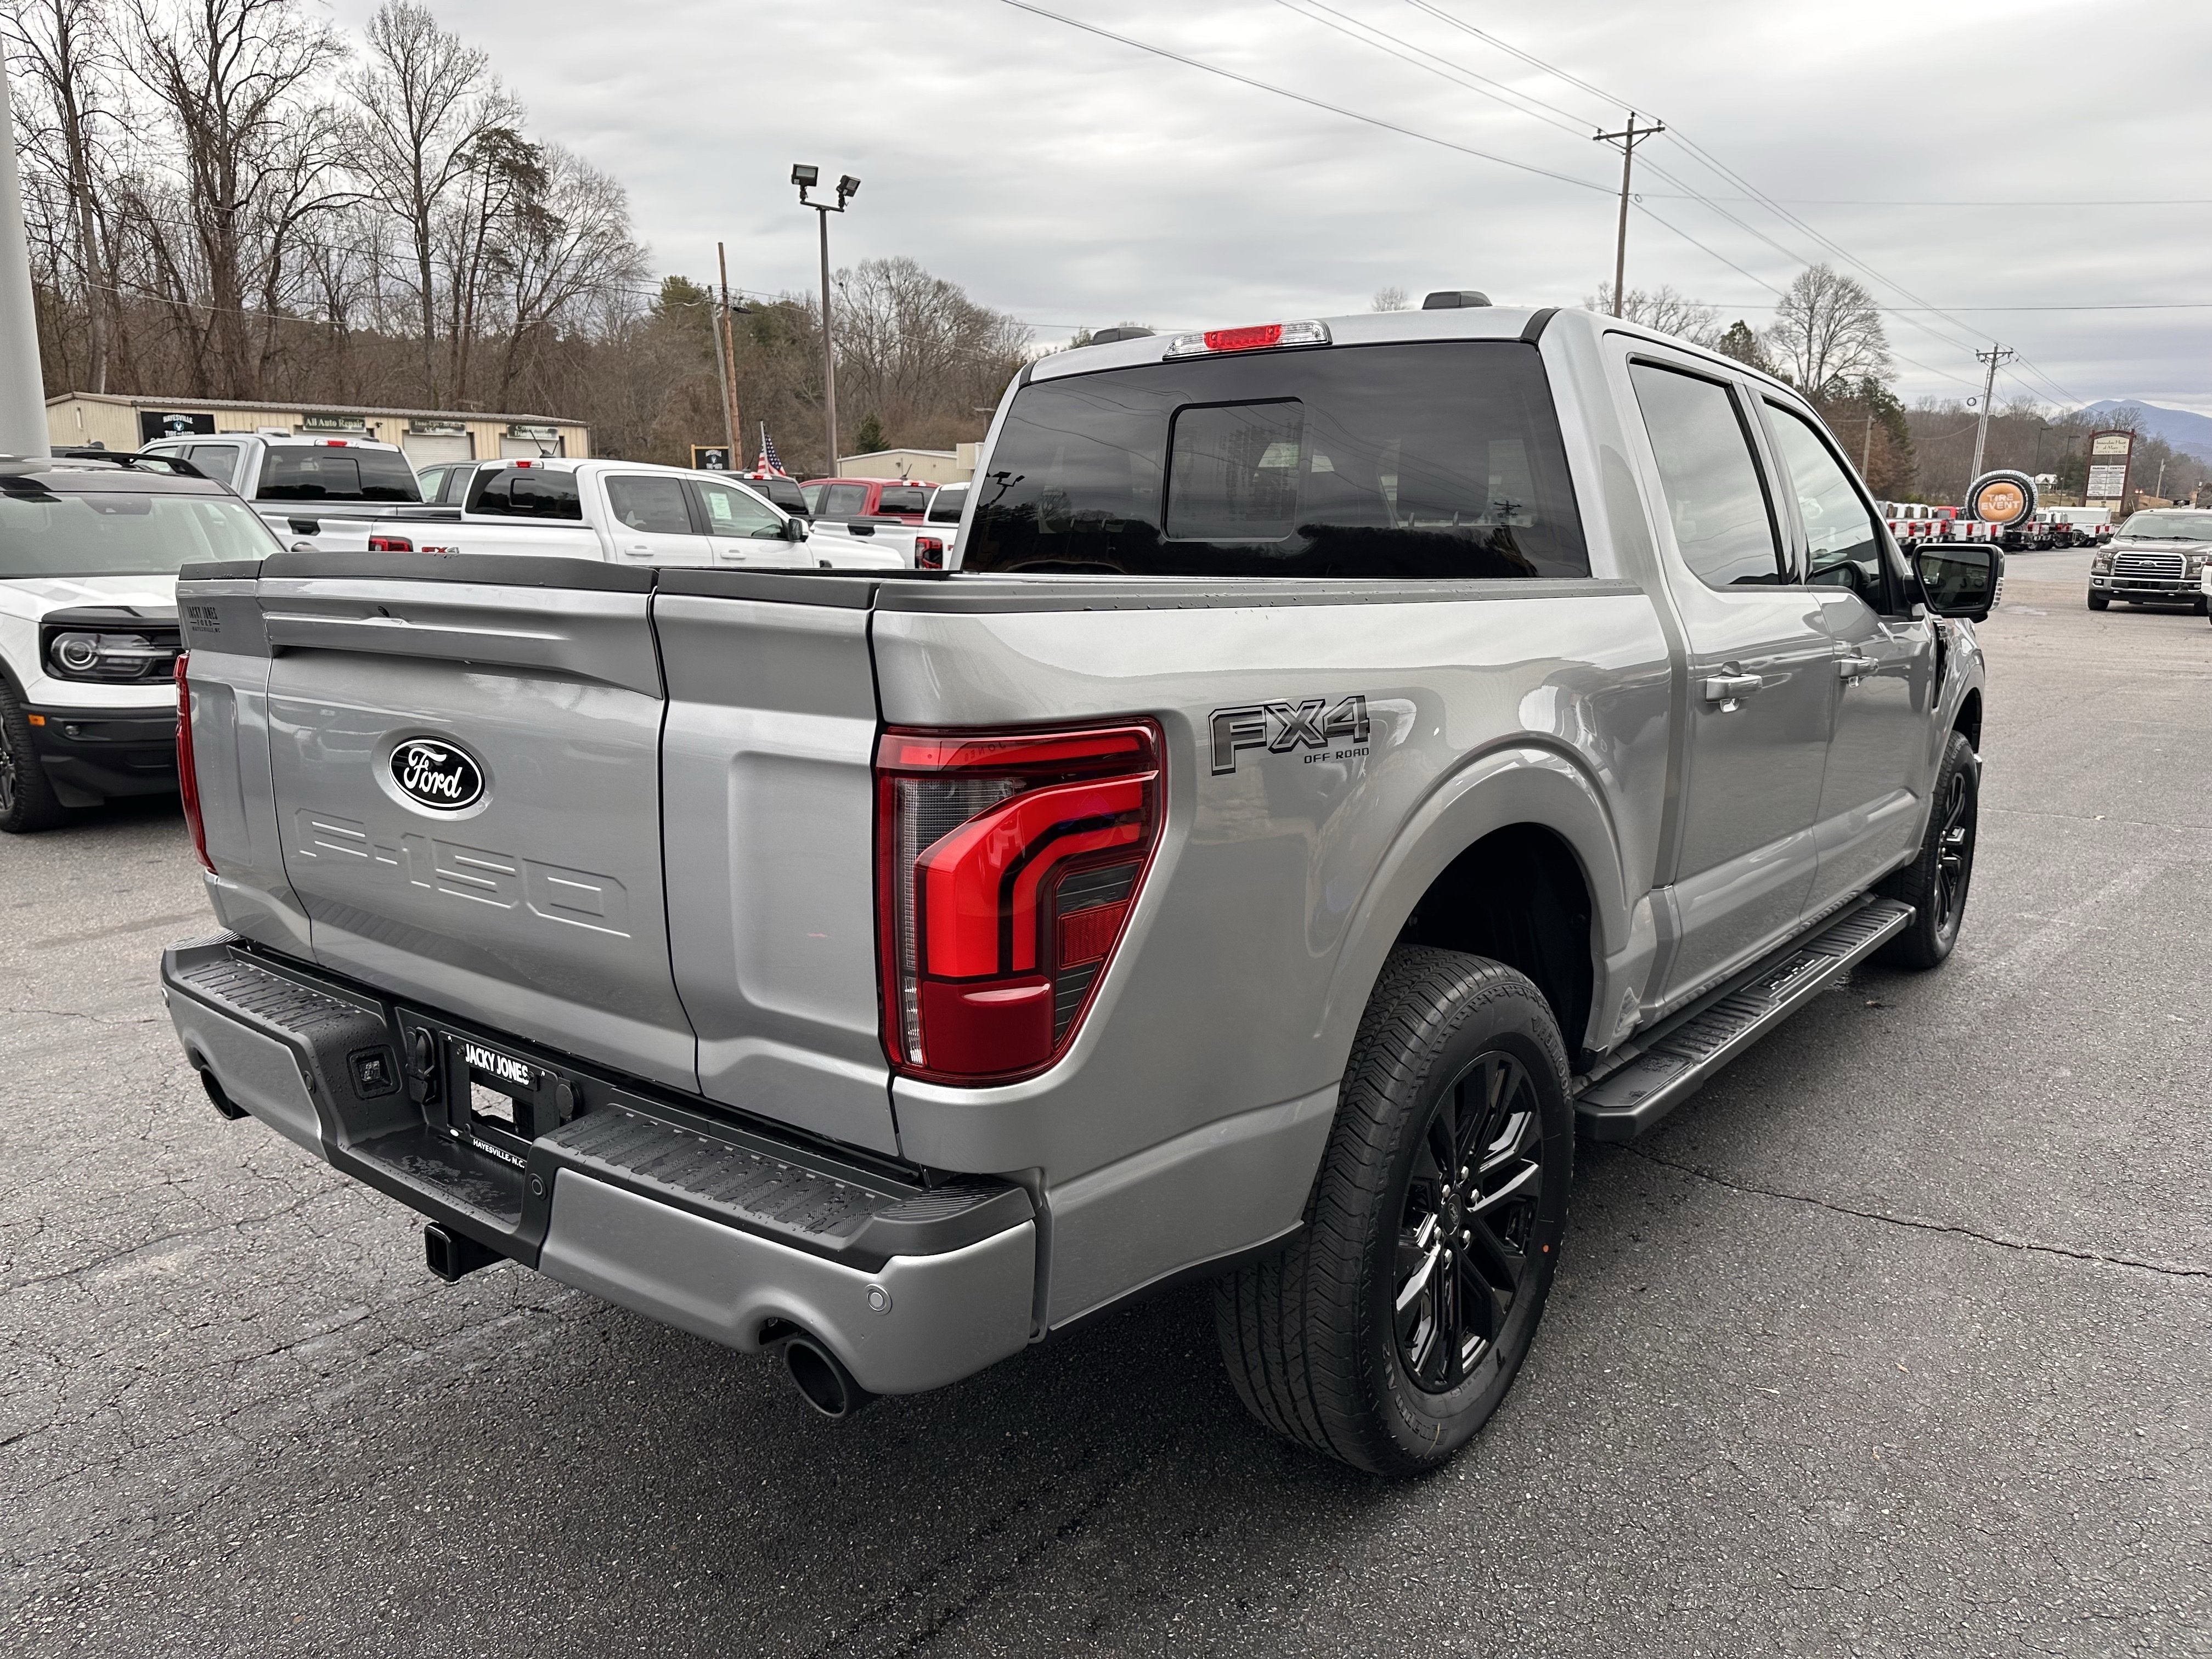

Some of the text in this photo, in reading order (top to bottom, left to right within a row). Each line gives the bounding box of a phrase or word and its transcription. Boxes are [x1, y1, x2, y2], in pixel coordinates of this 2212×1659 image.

[306, 418, 363, 430] All Auto Repair
[1981, 500, 2020, 510] EVENT
[1987, 493, 2014, 502] TIRE
[187, 606, 218, 620] JACKY JONES
[1207, 695, 1370, 776] FX4
[1304, 747, 1369, 764] OFF ROAD
[403, 747, 463, 799] Ford
[295, 808, 631, 939] F-150
[466, 1043, 530, 1085] JACKY JONES
[473, 1138, 511, 1161] HAYESVILLE,
